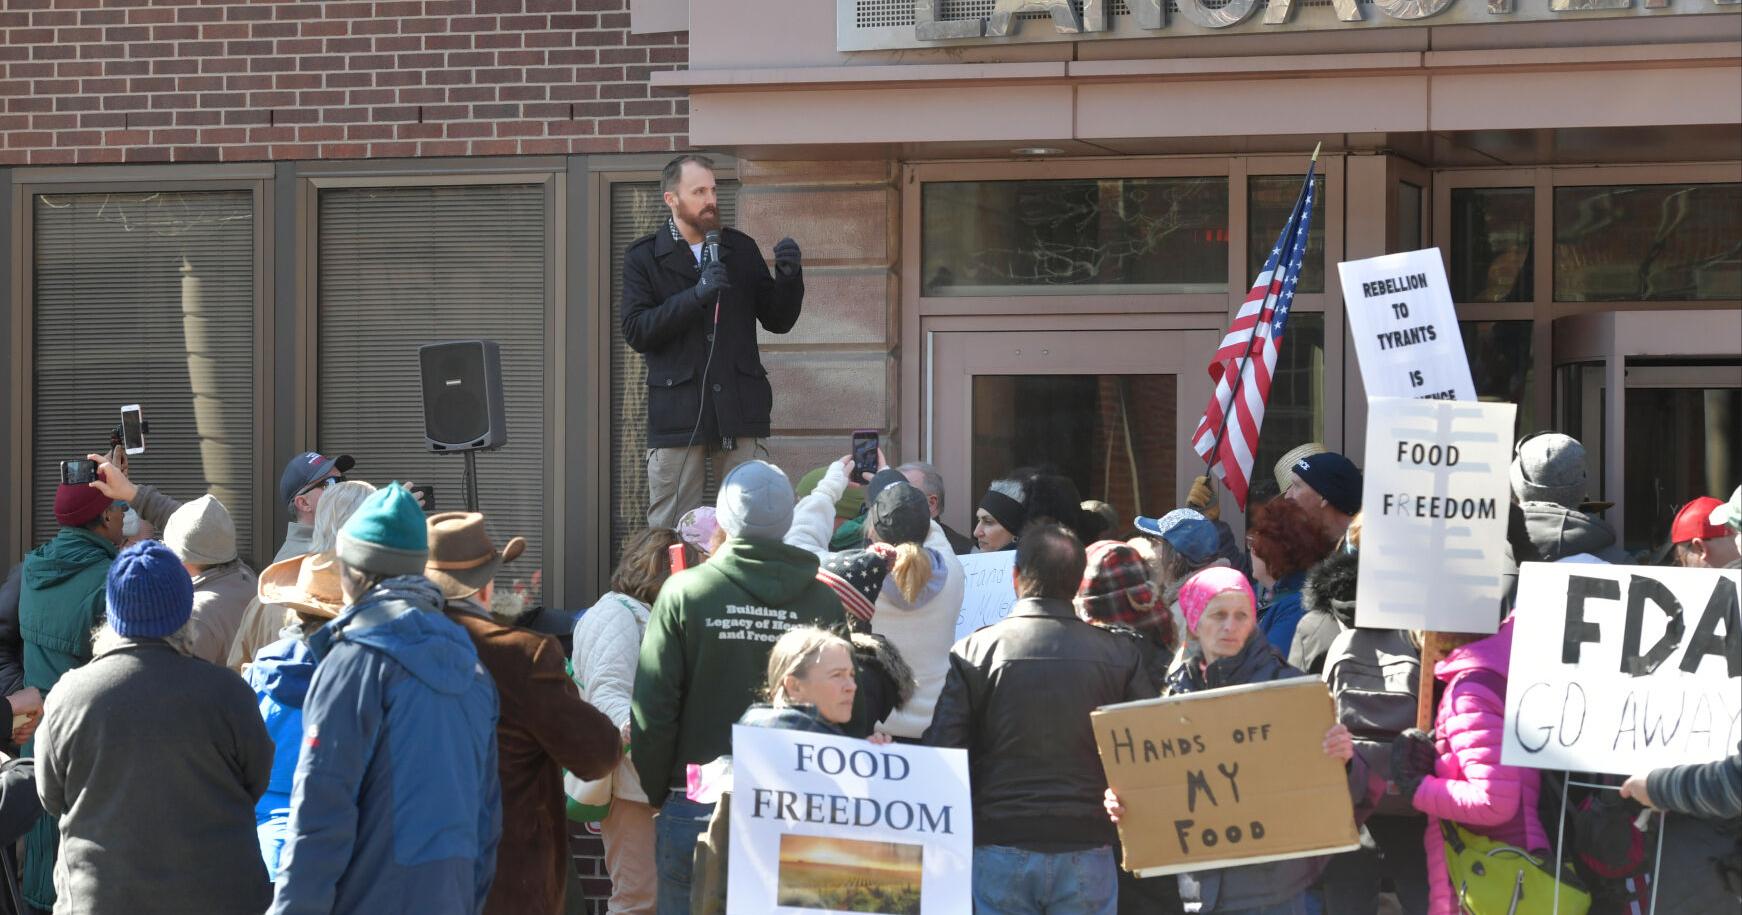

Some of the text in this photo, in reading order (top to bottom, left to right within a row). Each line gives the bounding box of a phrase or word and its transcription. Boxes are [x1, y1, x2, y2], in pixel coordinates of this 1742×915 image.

[1362, 273, 1428, 298] REBELLION
[1392, 302, 1409, 320] TO
[1377, 325, 1437, 350] TYRANTS
[1409, 370, 1424, 388] IS
[1397, 441, 1460, 467] FOOD
[1383, 493, 1496, 520] FREEDOM
[705, 618, 753, 629] Legacy
[755, 620, 769, 629] of
[726, 605, 798, 620] Building a
[718, 630, 745, 640] and
[1562, 574, 1742, 678] FDA
[1515, 682, 1742, 758] GO AWAY
[1111, 724, 1272, 764] HANDS OFF
[794, 743, 910, 781] FOOD
[1187, 762, 1240, 813] MY
[752, 788, 954, 835] FREEDOM
[1174, 819, 1266, 855] FOOD
